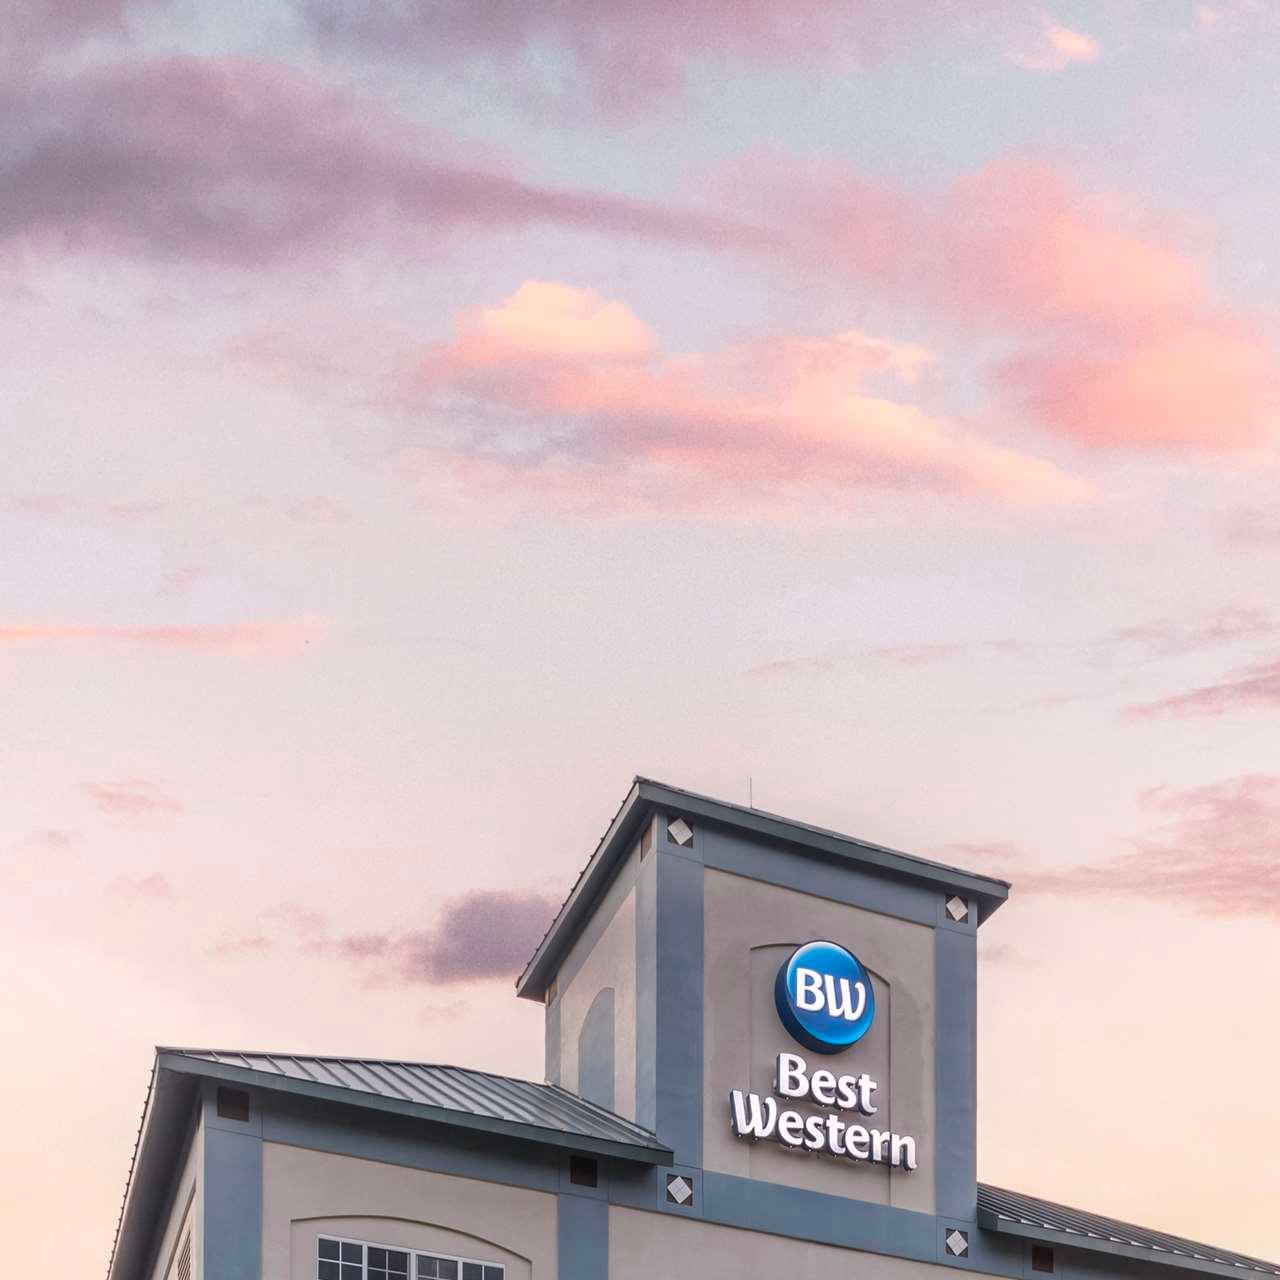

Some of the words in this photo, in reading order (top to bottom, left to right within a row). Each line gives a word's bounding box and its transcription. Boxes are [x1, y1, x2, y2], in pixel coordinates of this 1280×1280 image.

[796, 968, 866, 1021] BW
[776, 1052, 878, 1115] Best
[730, 1089, 918, 1170] Western
